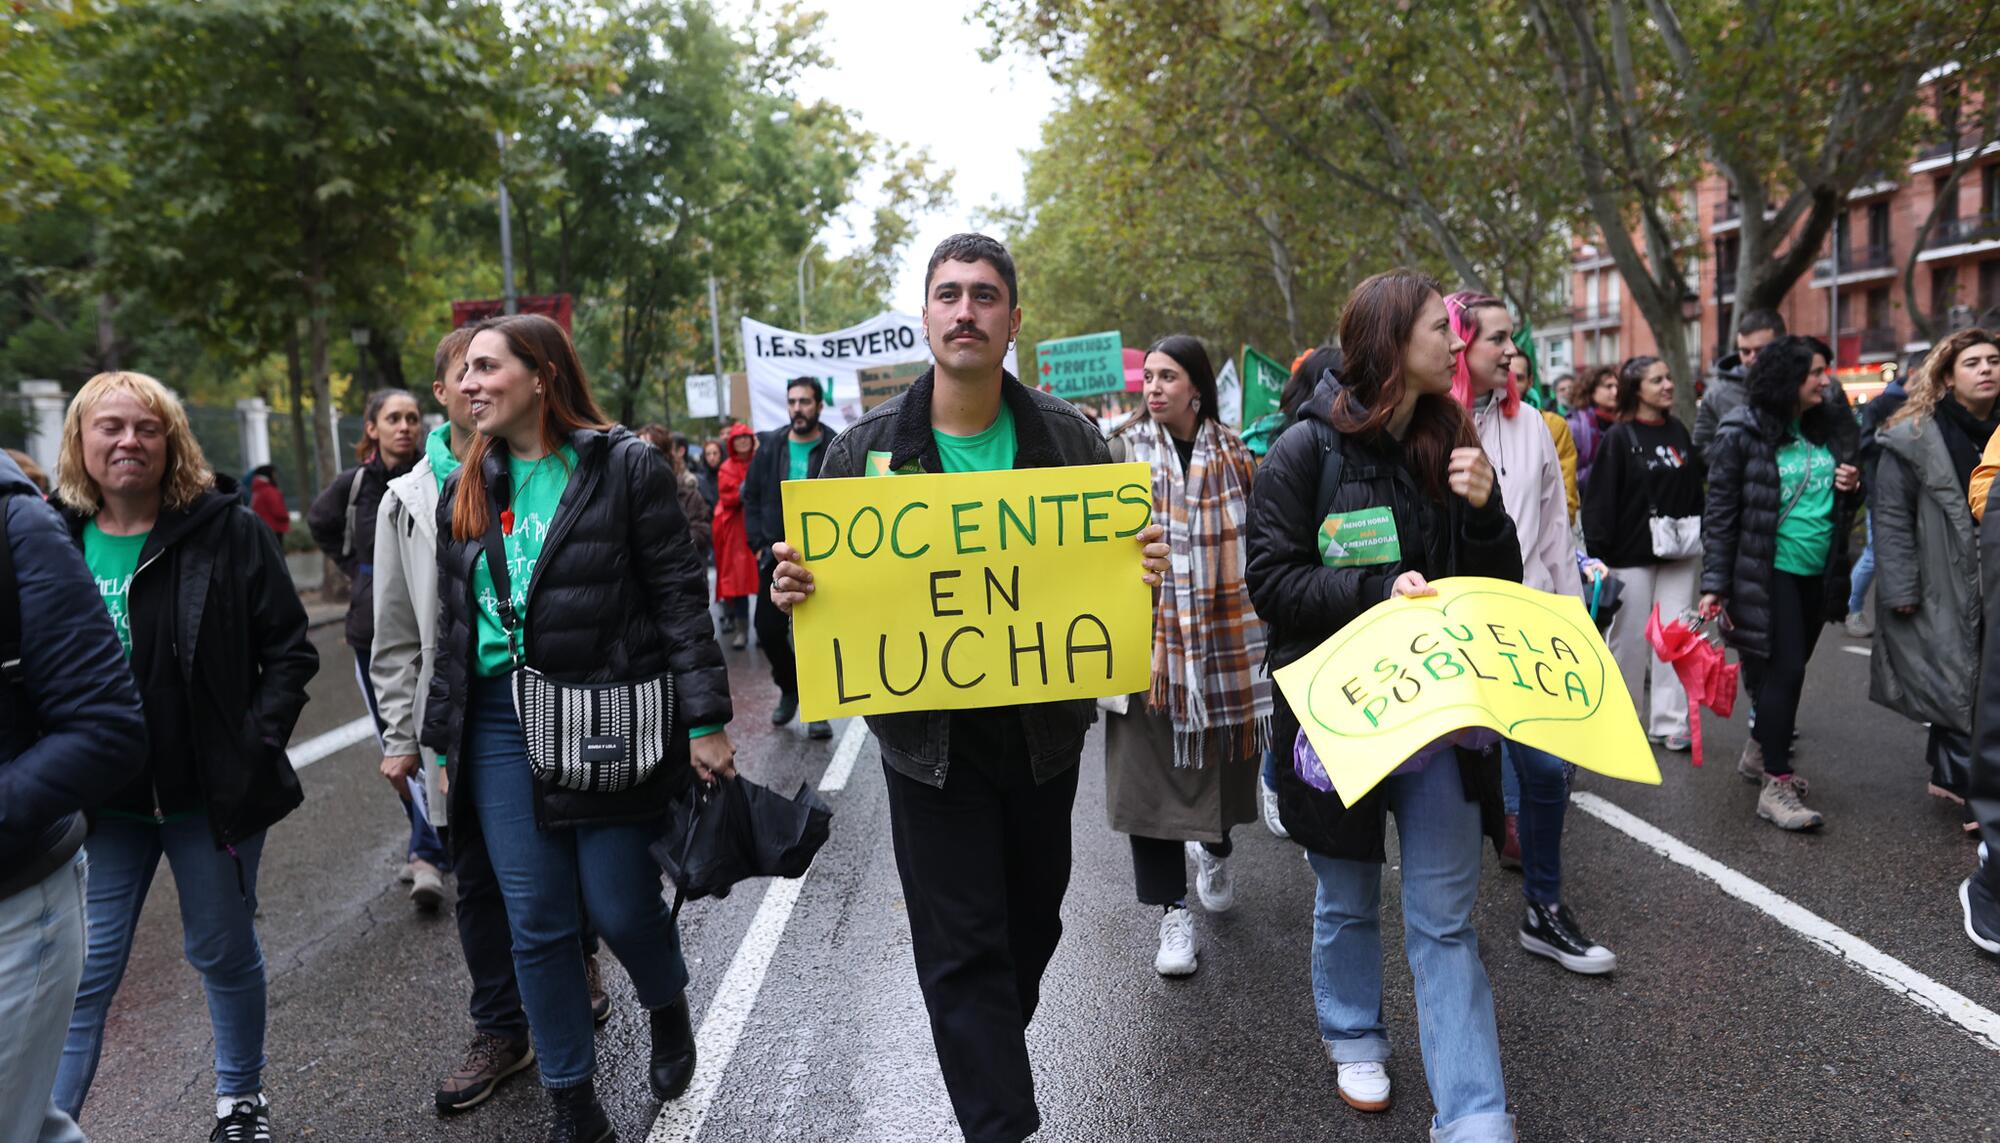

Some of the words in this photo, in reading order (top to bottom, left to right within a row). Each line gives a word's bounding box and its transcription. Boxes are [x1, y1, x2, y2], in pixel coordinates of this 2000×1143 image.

[755, 334, 816, 359] I.E.S.
[821, 325, 915, 359] SEVERO
[1054, 356, 1107, 375] PROFES
[1055, 373, 1117, 394] CALIDAD
[800, 483, 1152, 562] DOCENTES
[1343, 520, 1367, 529] MENOS
[1367, 515, 1390, 526] HORAS
[929, 565, 1020, 618] EN
[832, 613, 1113, 705] LUCHA
[1340, 623, 1580, 706] ESCUELA
[1363, 647, 1590, 729] PÚBLICA
